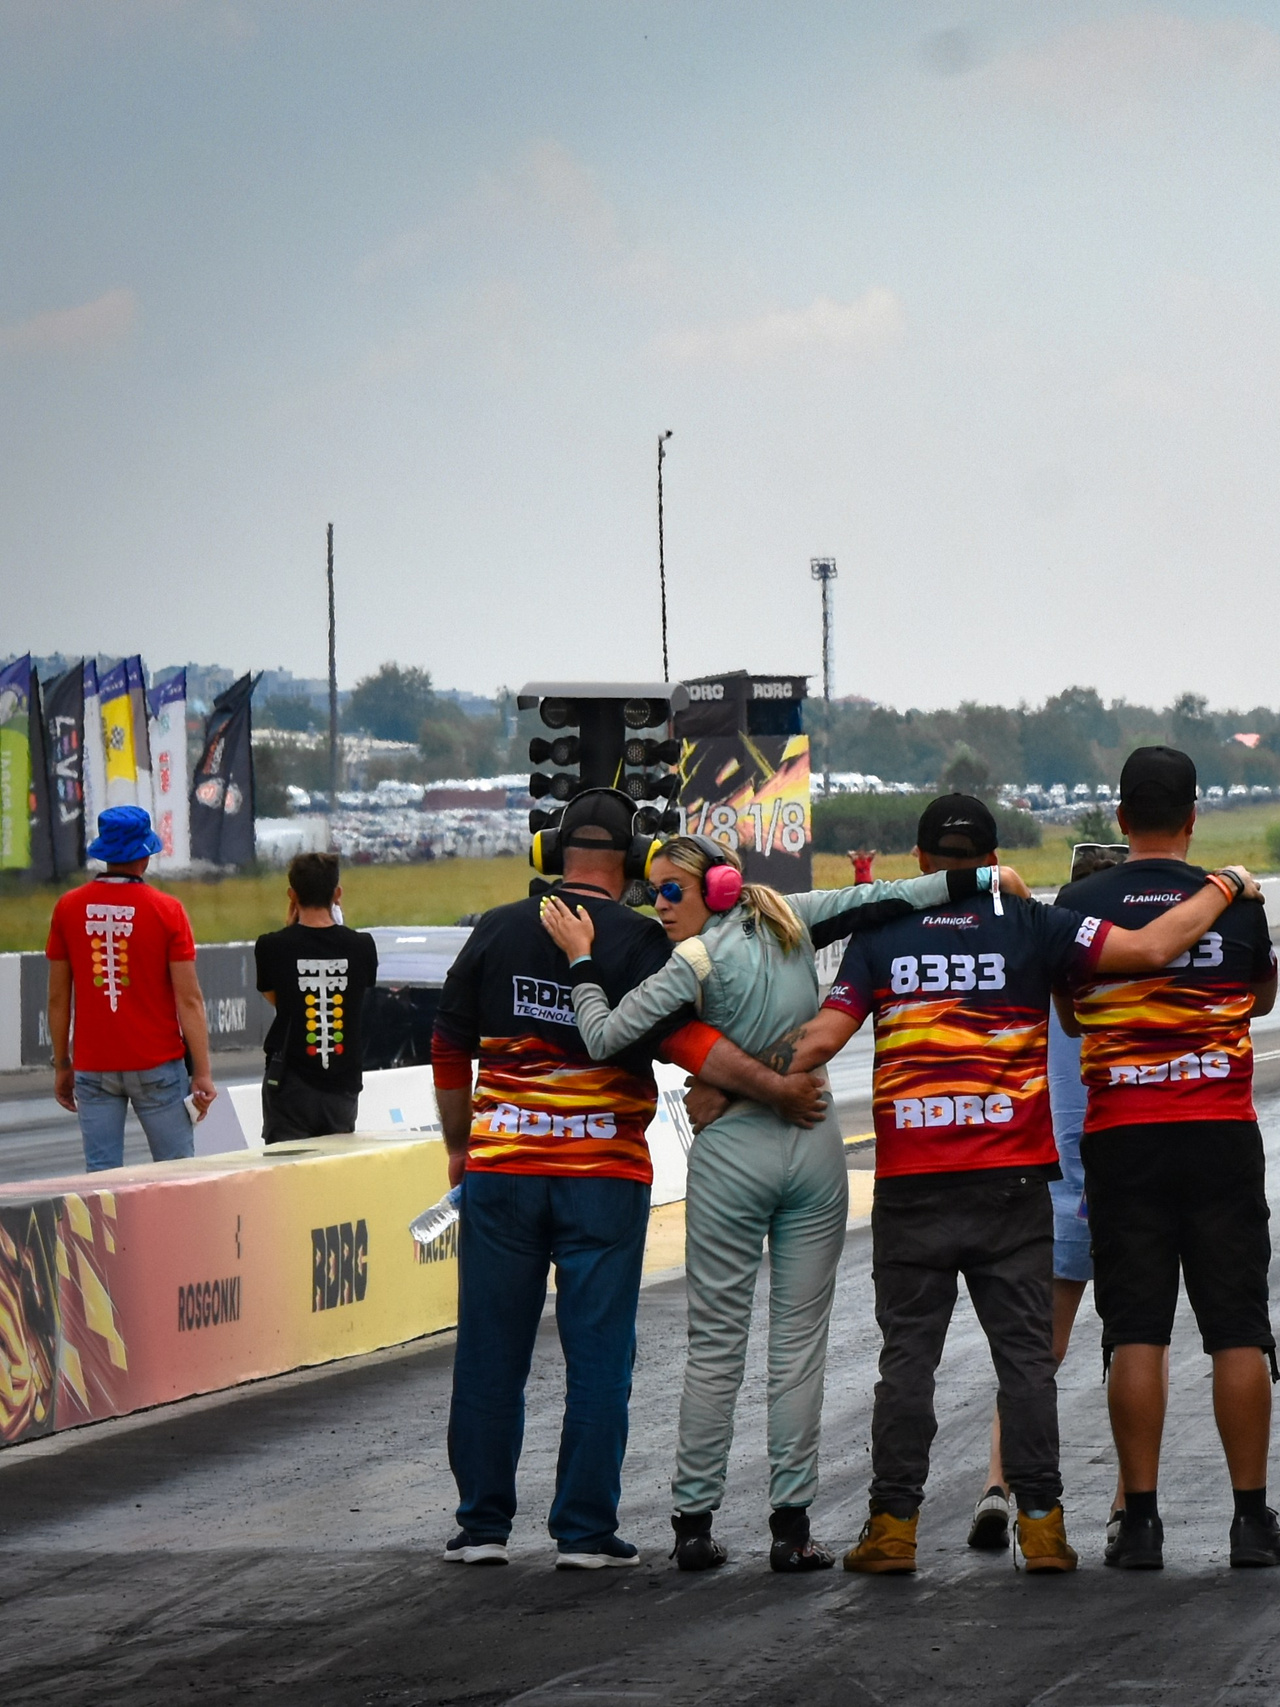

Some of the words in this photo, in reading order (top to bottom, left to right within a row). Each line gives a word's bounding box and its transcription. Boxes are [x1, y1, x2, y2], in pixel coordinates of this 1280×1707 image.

[688, 683, 724, 700] DRC
[748, 798, 805, 857] 1/8
[1123, 893, 1182, 903] FLAMHOLC
[922, 915, 974, 925] FLAMHOLC
[890, 954, 1006, 995] 8333
[515, 978, 575, 1013] RDR
[893, 1093, 1014, 1130] RDRC
[419, 1221, 459, 1265] RACEPA
[178, 1276, 241, 1332] ROSGONKI
